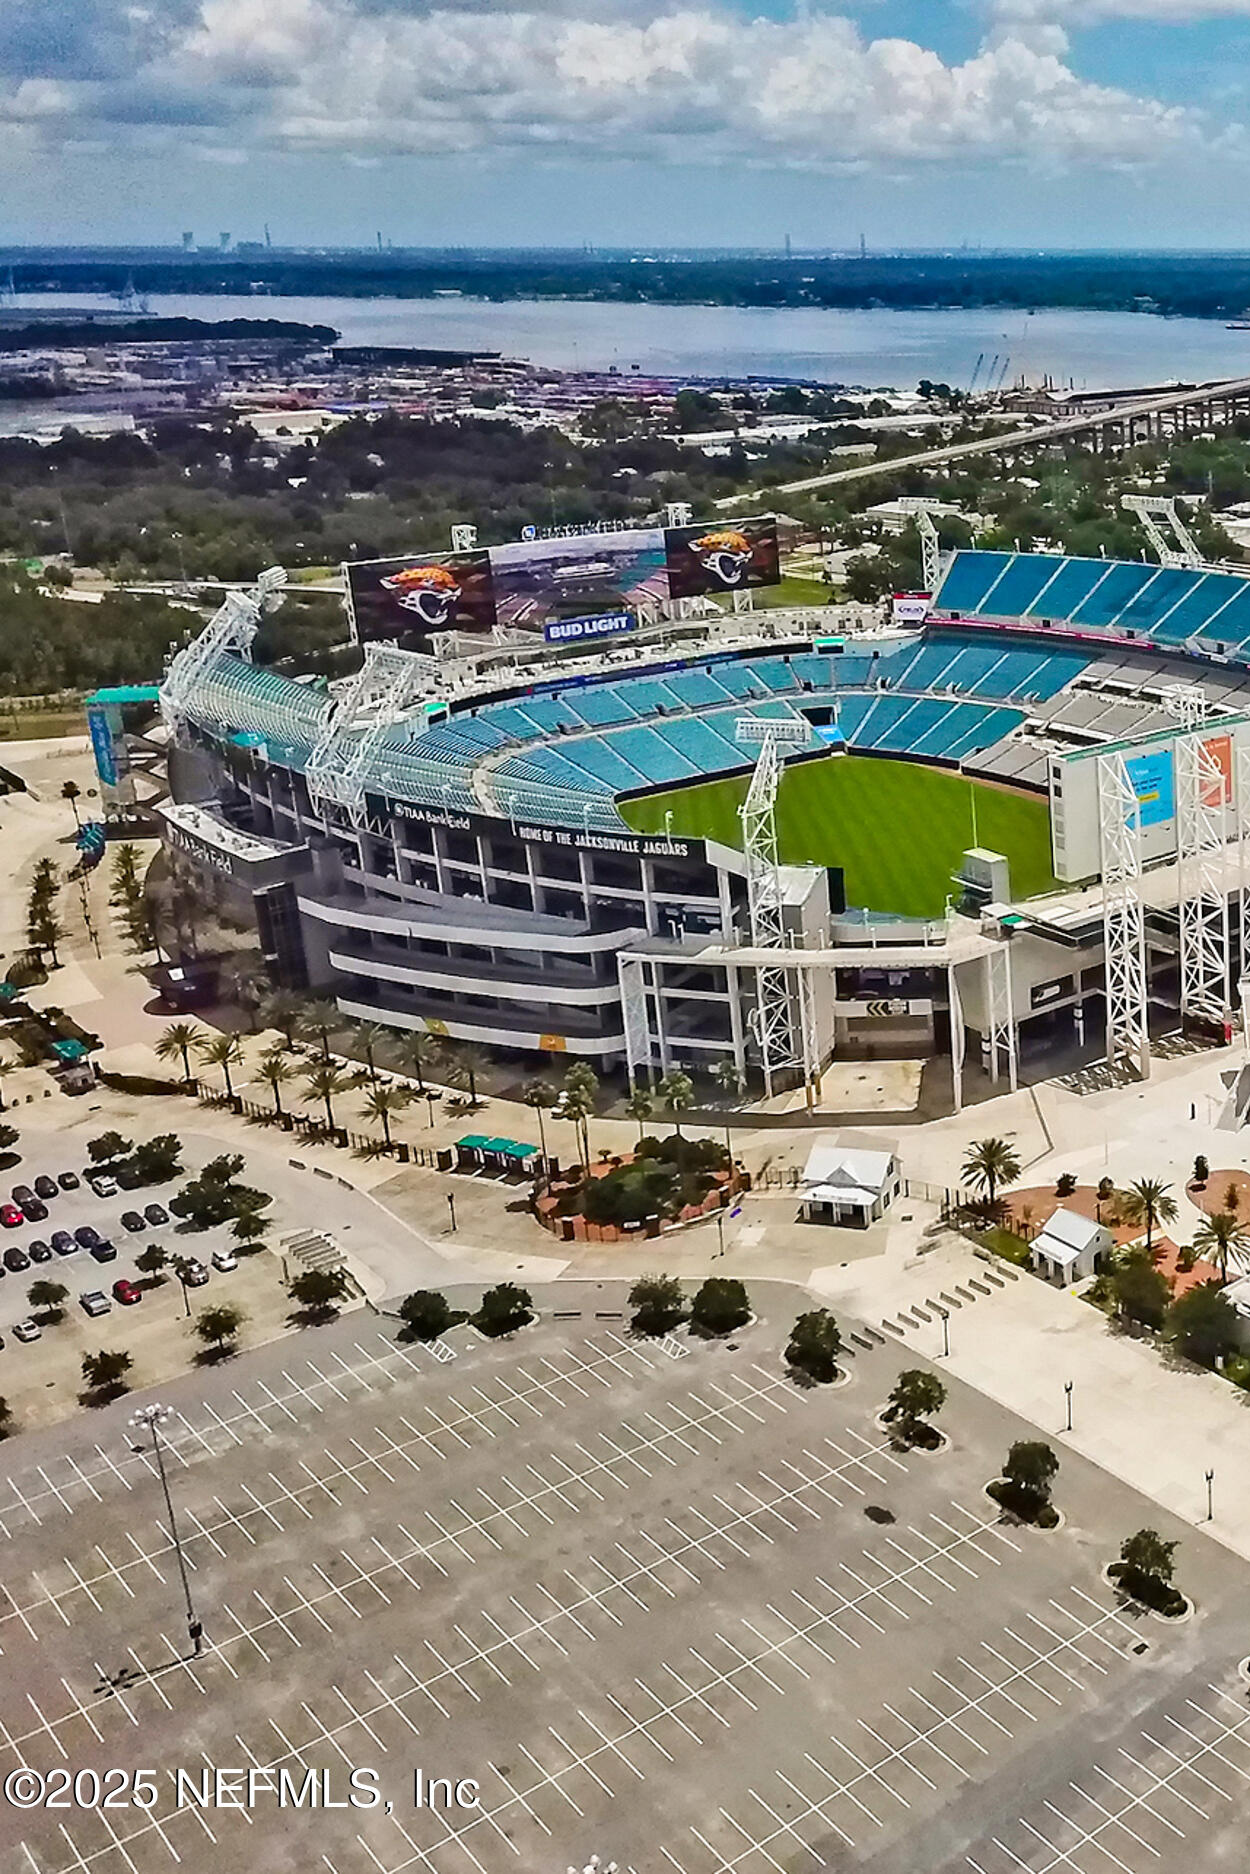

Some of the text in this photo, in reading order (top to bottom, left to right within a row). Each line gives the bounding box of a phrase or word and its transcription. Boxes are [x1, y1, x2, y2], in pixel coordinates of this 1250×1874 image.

[549, 616, 628, 639] BUD LIGHT
[403, 806, 425, 821] TIAA
[518, 827, 688, 857] HOME OF THE JACKSONVILLE JAGUARS
